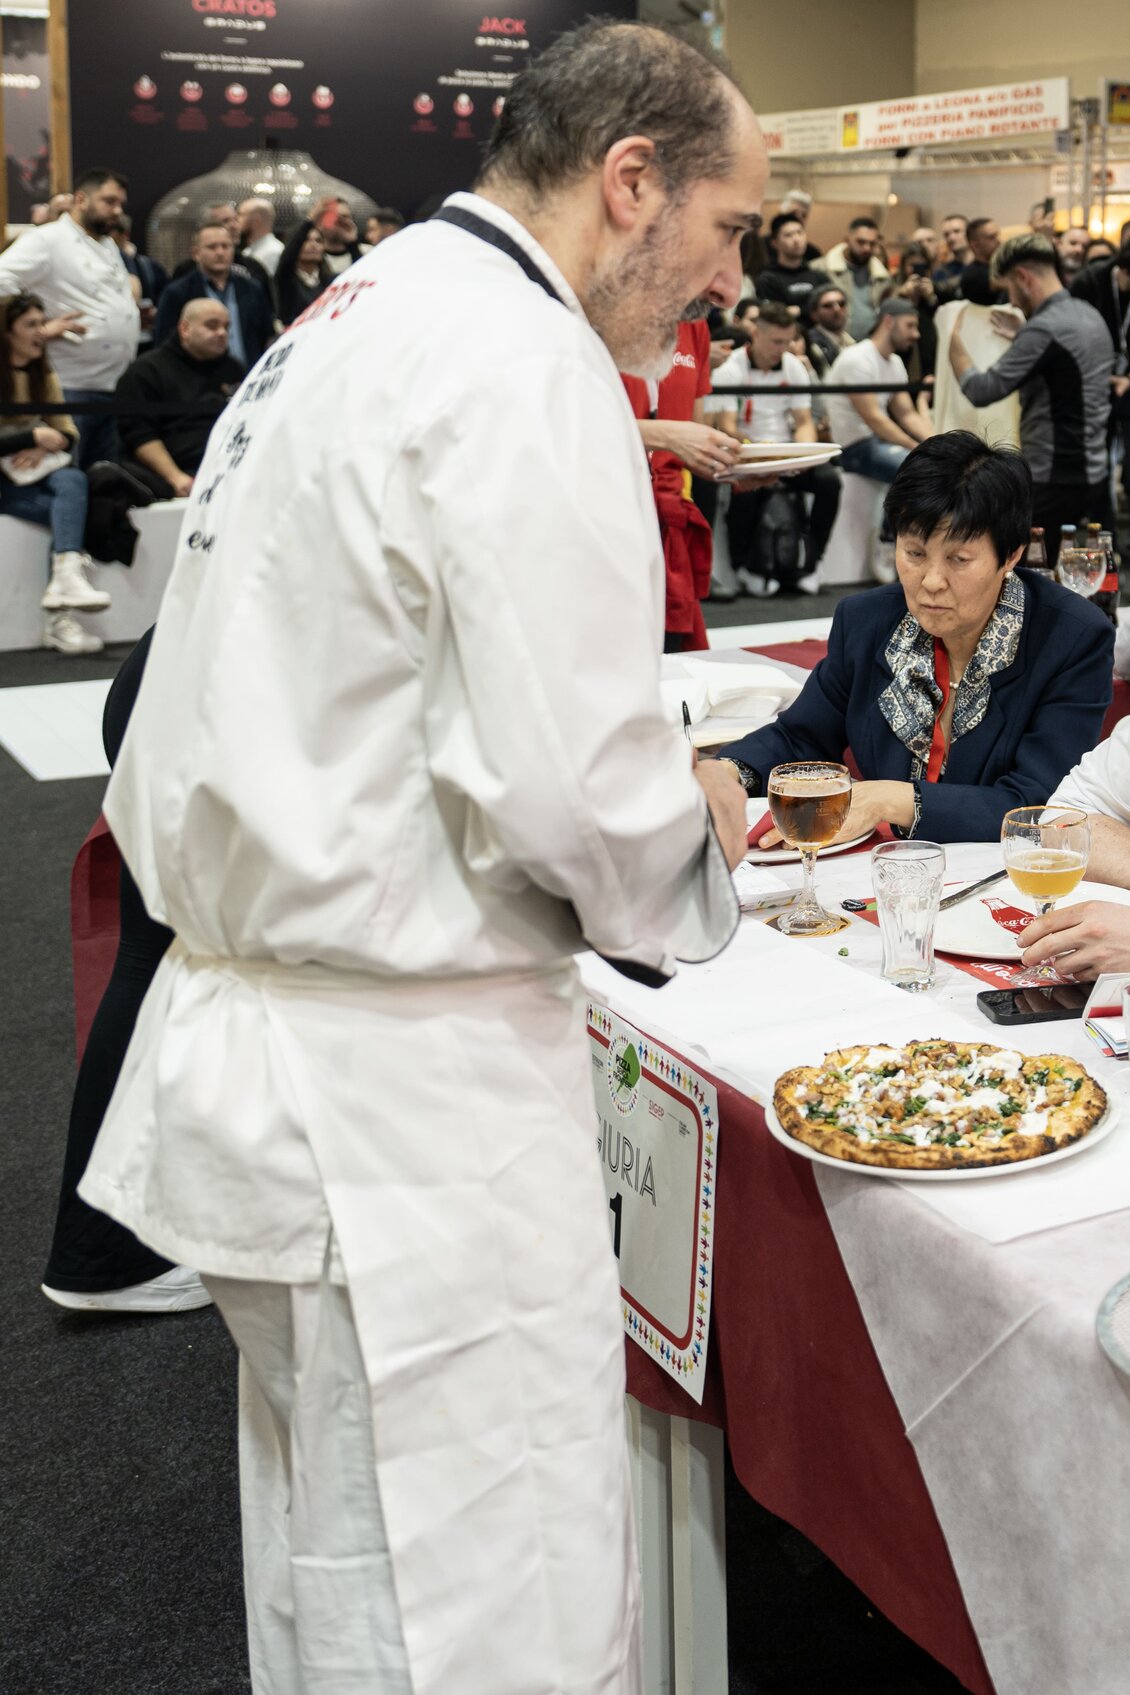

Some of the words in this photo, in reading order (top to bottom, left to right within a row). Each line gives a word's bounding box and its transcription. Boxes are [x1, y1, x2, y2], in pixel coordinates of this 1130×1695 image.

[478, 16, 527, 35] JACK
[902, 113, 964, 128] PIZZERIA
[609, 1192, 622, 1259] 1
